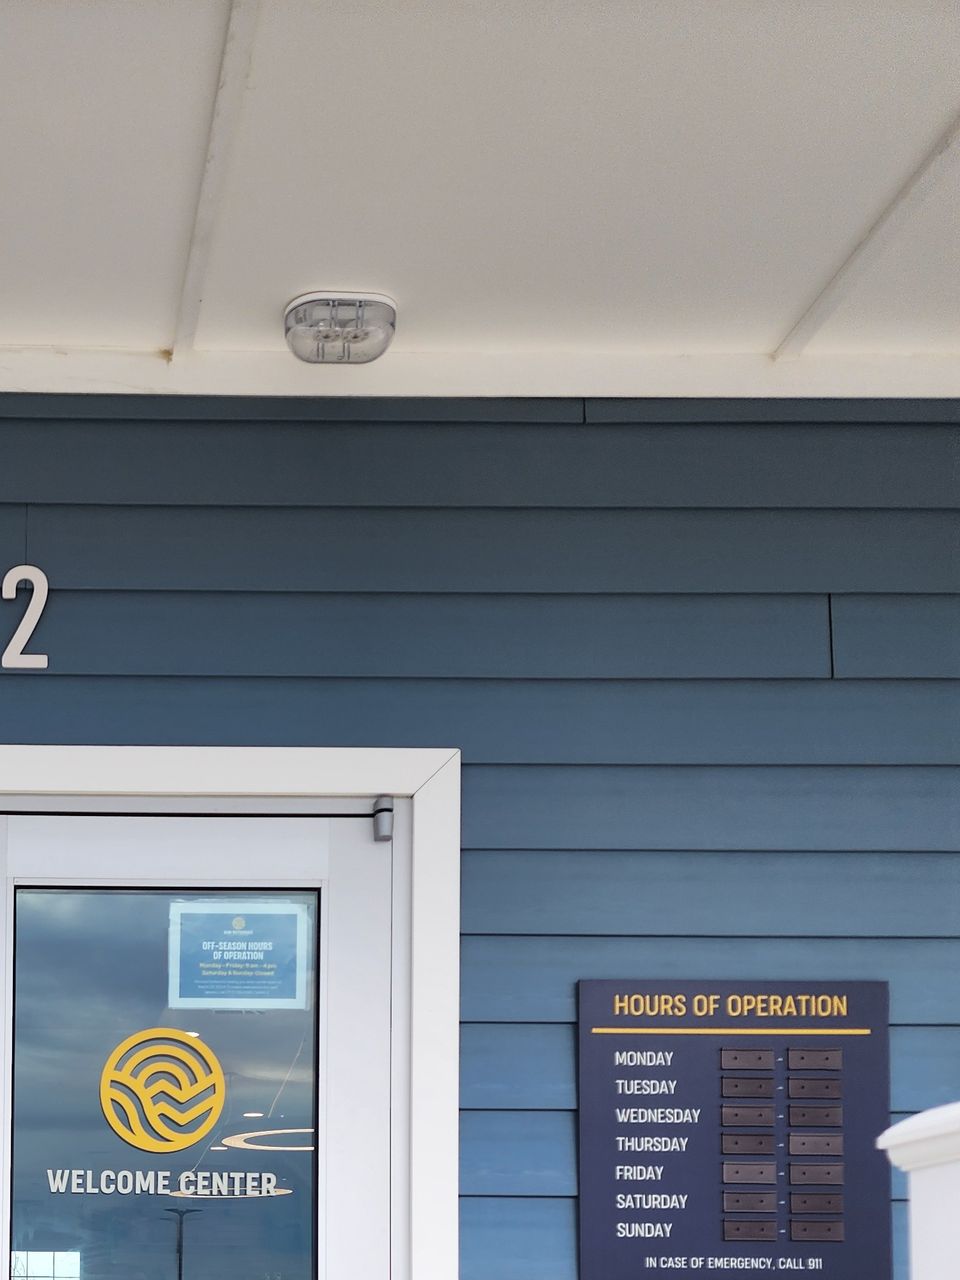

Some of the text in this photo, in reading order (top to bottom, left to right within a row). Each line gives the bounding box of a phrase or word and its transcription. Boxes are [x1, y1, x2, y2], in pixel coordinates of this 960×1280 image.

[203, 942, 272, 951] OFF-SEASON HOURS
[213, 951, 263, 960] OF OPERATION
[614, 994, 848, 1017] HOURS OF OPERATION
[615, 1051, 674, 1066] MONDAY
[615, 1080, 677, 1095] TUESDAY
[616, 1109, 700, 1123] WEDNESDAY
[616, 1138, 689, 1152] THURSDAY
[615, 1166, 663, 1181] FRIDAY
[47, 1169, 277, 1196] WELCOME CENTER
[616, 1194, 688, 1209] SATURDAY
[616, 1223, 673, 1238] SUNDAY
[646, 1257, 823, 1270] IN CASE OF EMERGENCY, CALL 911
